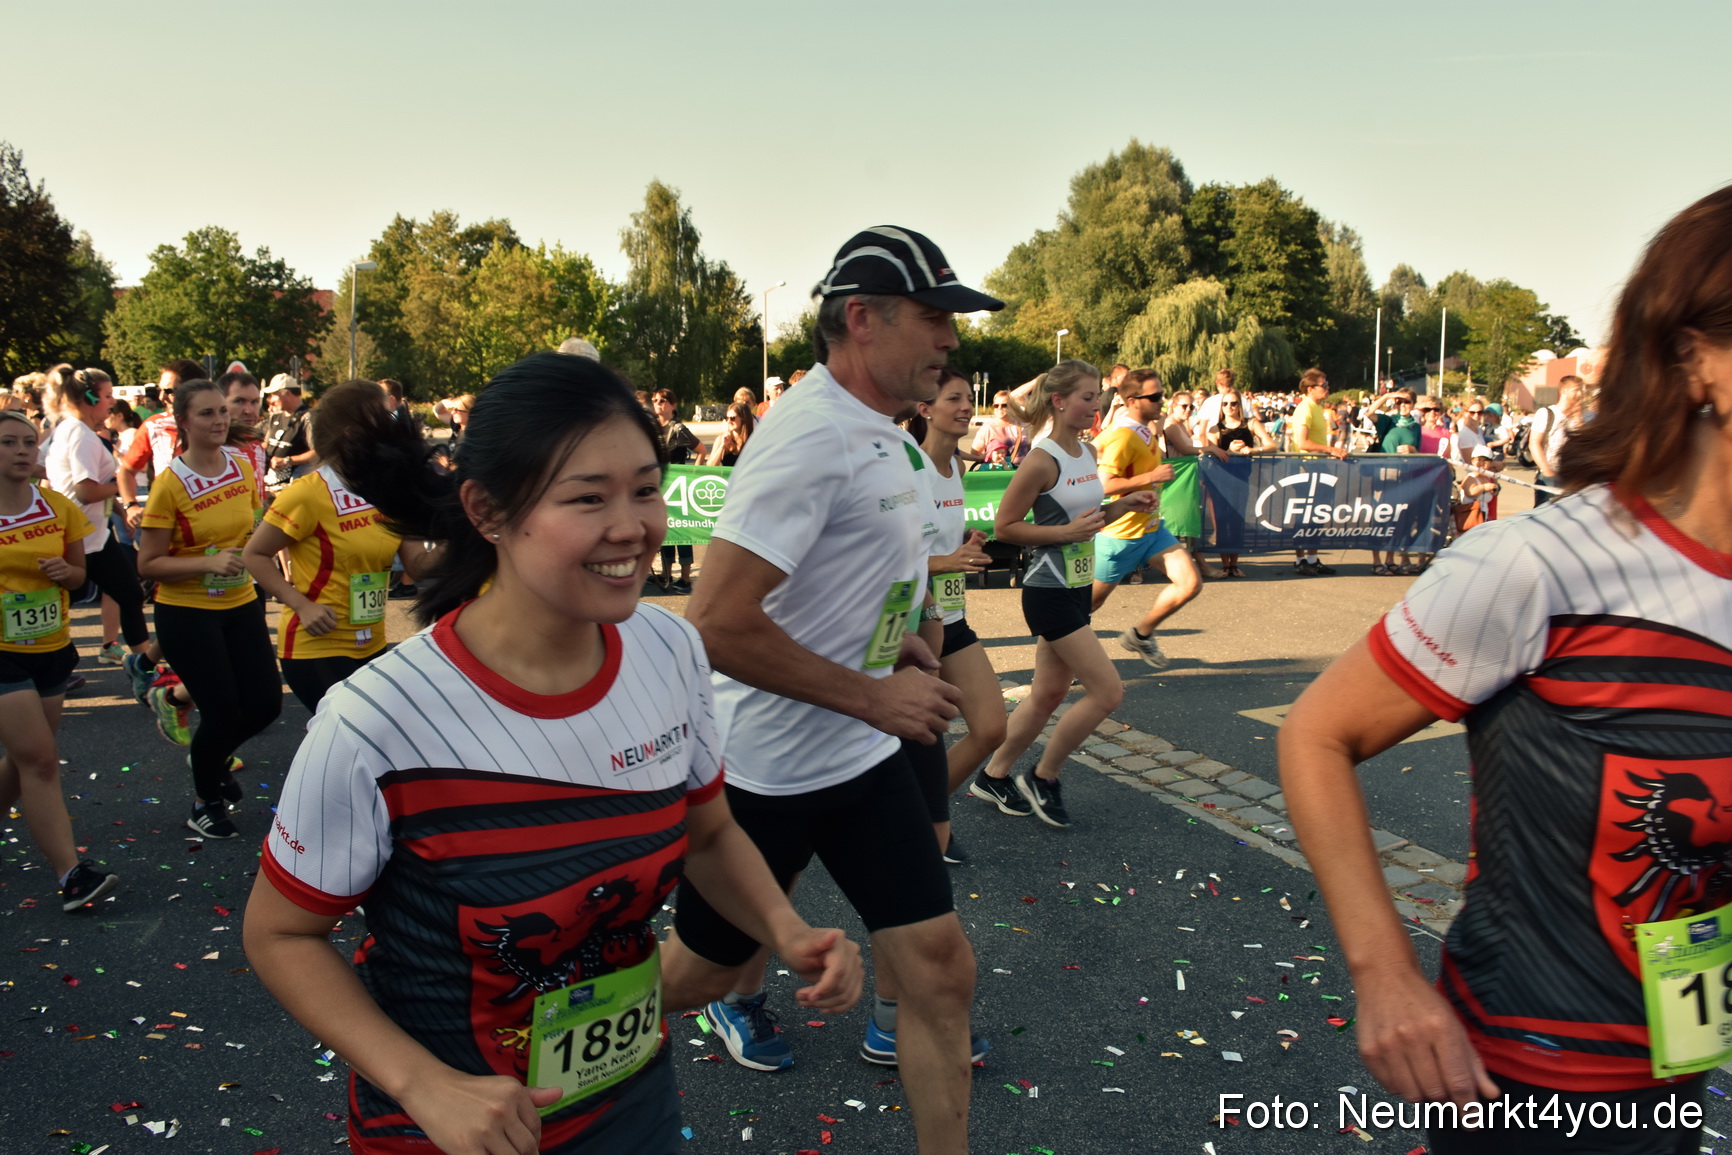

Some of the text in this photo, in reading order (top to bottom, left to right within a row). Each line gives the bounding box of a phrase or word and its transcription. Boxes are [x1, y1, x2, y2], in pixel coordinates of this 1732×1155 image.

[194, 484, 249, 512] MAX BÖGL
[1283, 496, 1409, 525] Fischer
[338, 515, 371, 533] MAX
[963, 502, 1000, 521] nd
[22, 523, 63, 541] BÖGL
[1292, 526, 1396, 539] AUTOMOBILE
[11, 603, 58, 627] 1319
[610, 726, 681, 772] NEUMARKT
[553, 988, 657, 1074] 1898
[576, 1045, 641, 1080] Yano Keiko
